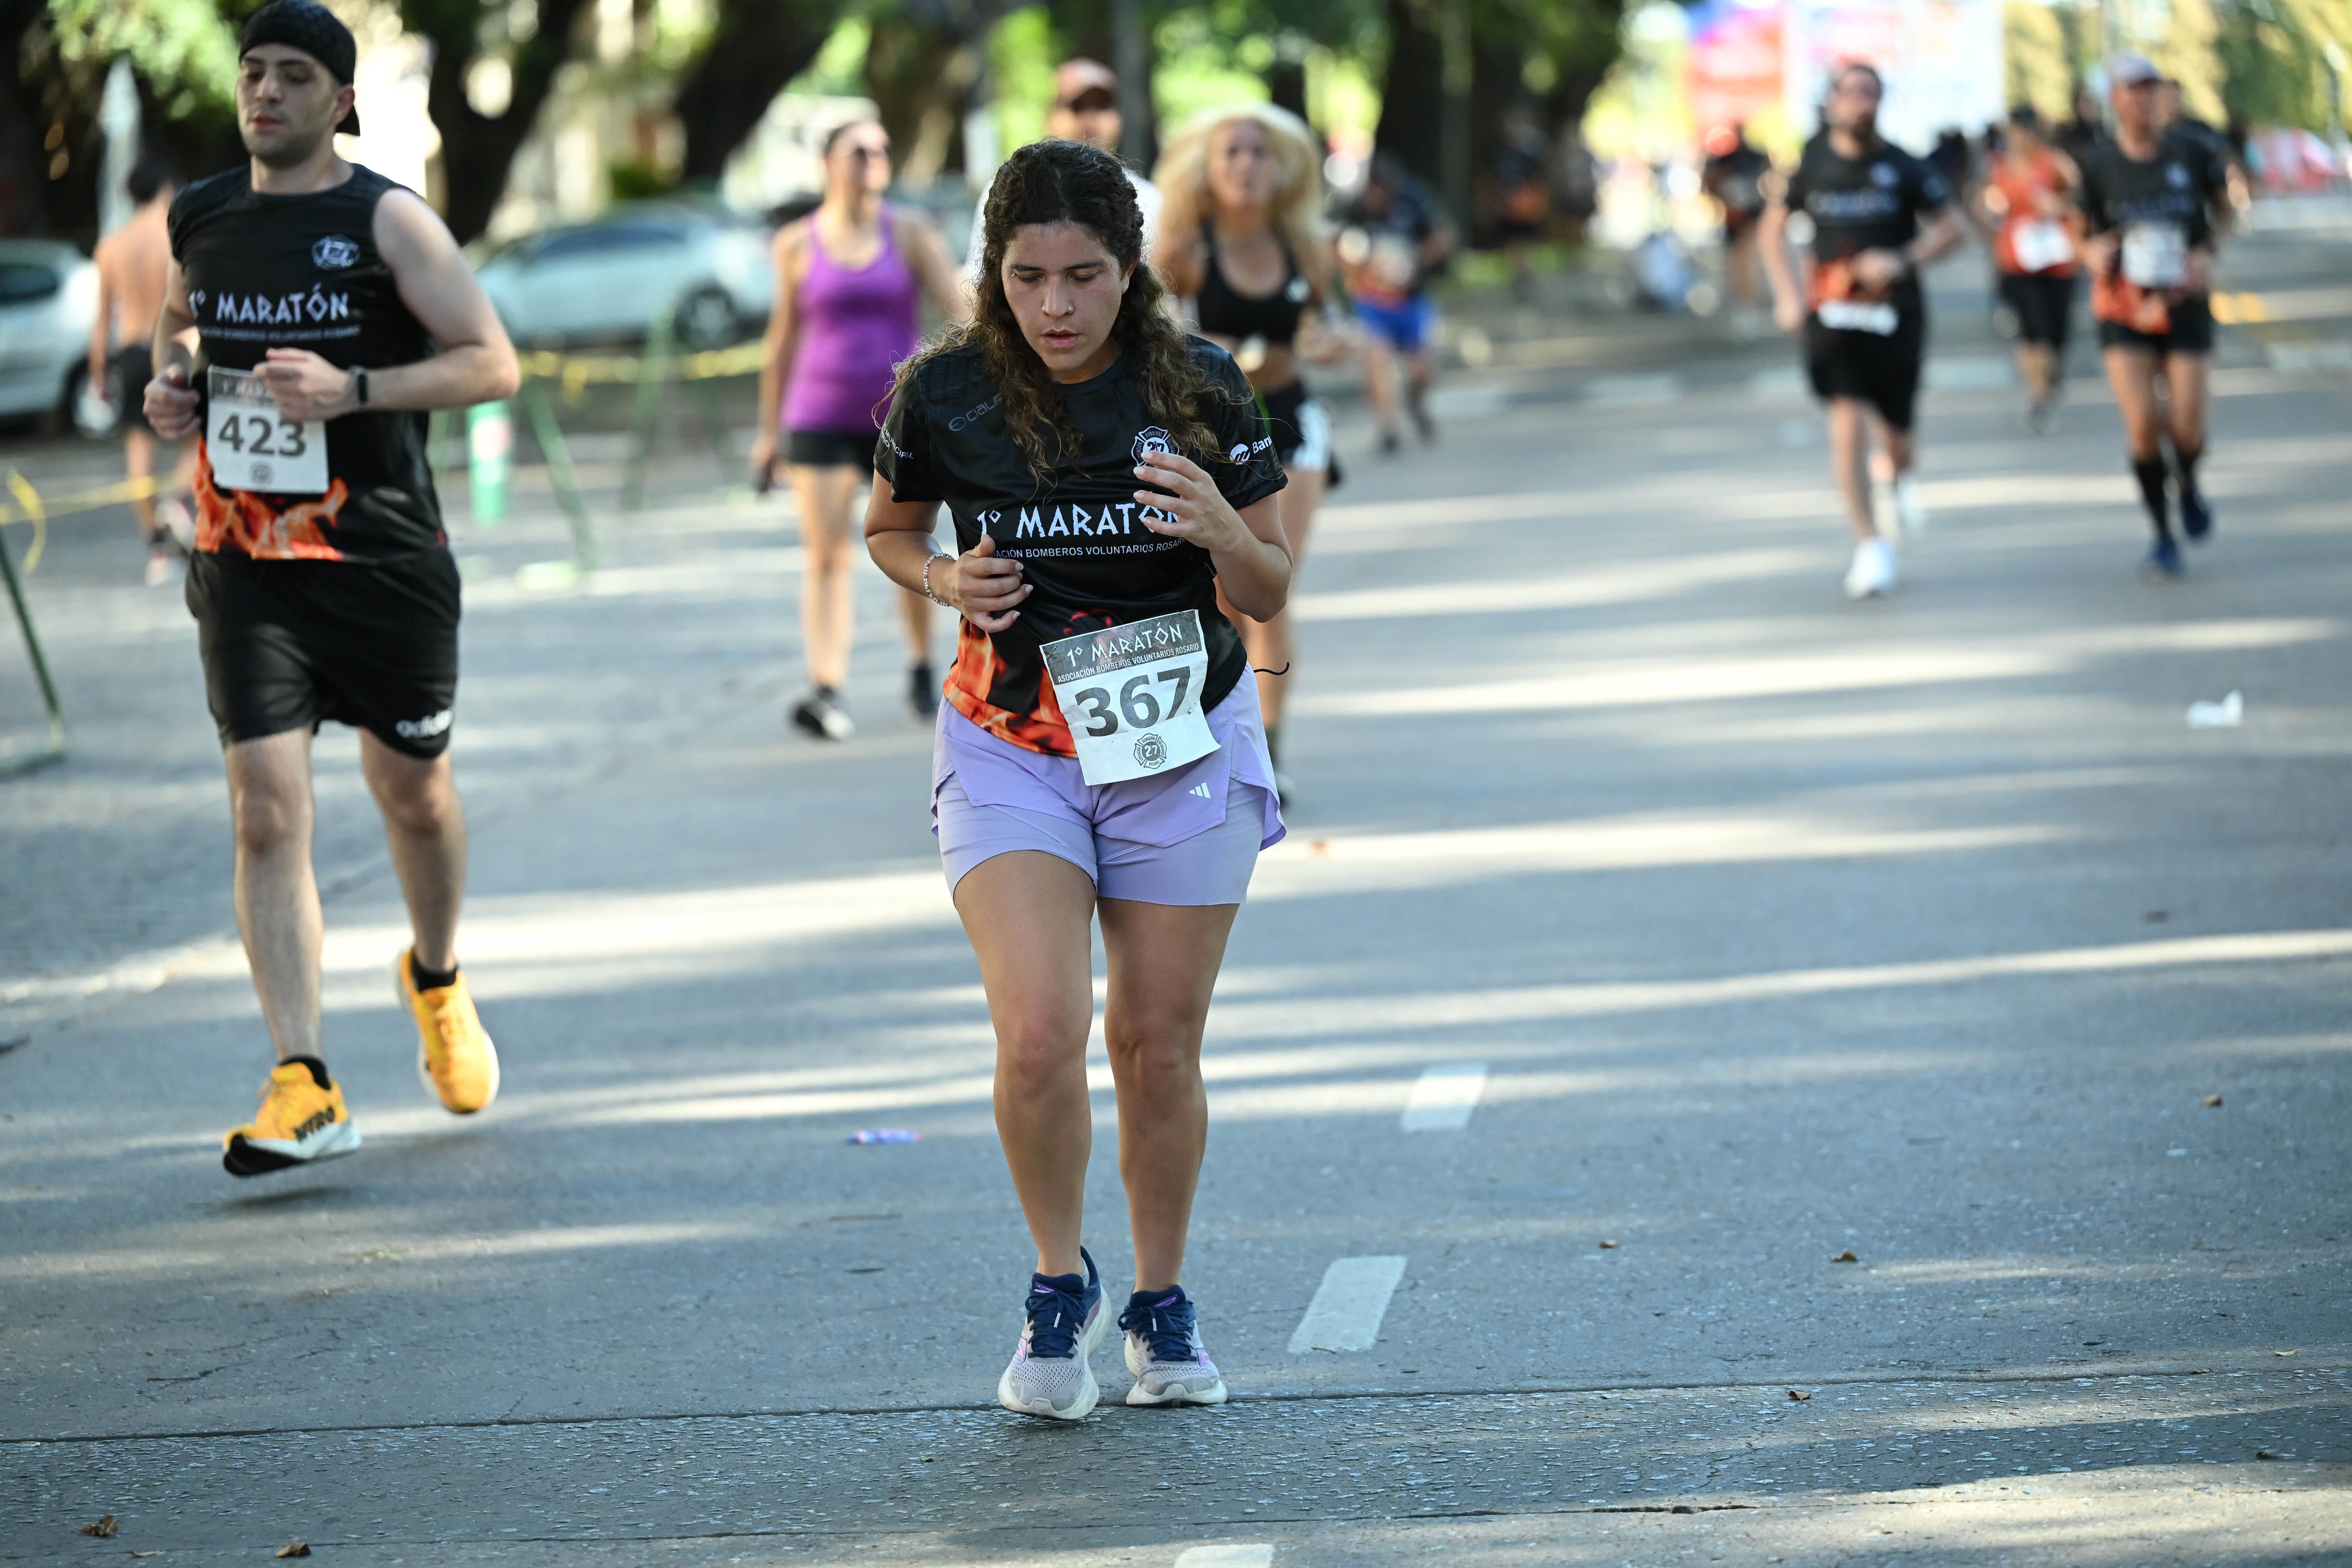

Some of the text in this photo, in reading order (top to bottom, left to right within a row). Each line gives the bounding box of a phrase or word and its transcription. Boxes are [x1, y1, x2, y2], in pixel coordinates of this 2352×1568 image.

[216, 282, 349, 324] MARATÓN
[219, 413, 306, 458] 423
[1252, 435, 1272, 454] Ban
[1026, 547, 1083, 557] BOMBEROS
[1085, 544, 1154, 555] VOLUNTARIOS
[1092, 621, 1183, 662] MARATÓN
[1057, 643, 1199, 683] ASOCIACIÓN BOMBEROS VOLUNTARIOS ROSARIO
[1075, 666, 1190, 737] 367
[1144, 745, 1158, 758] 27
